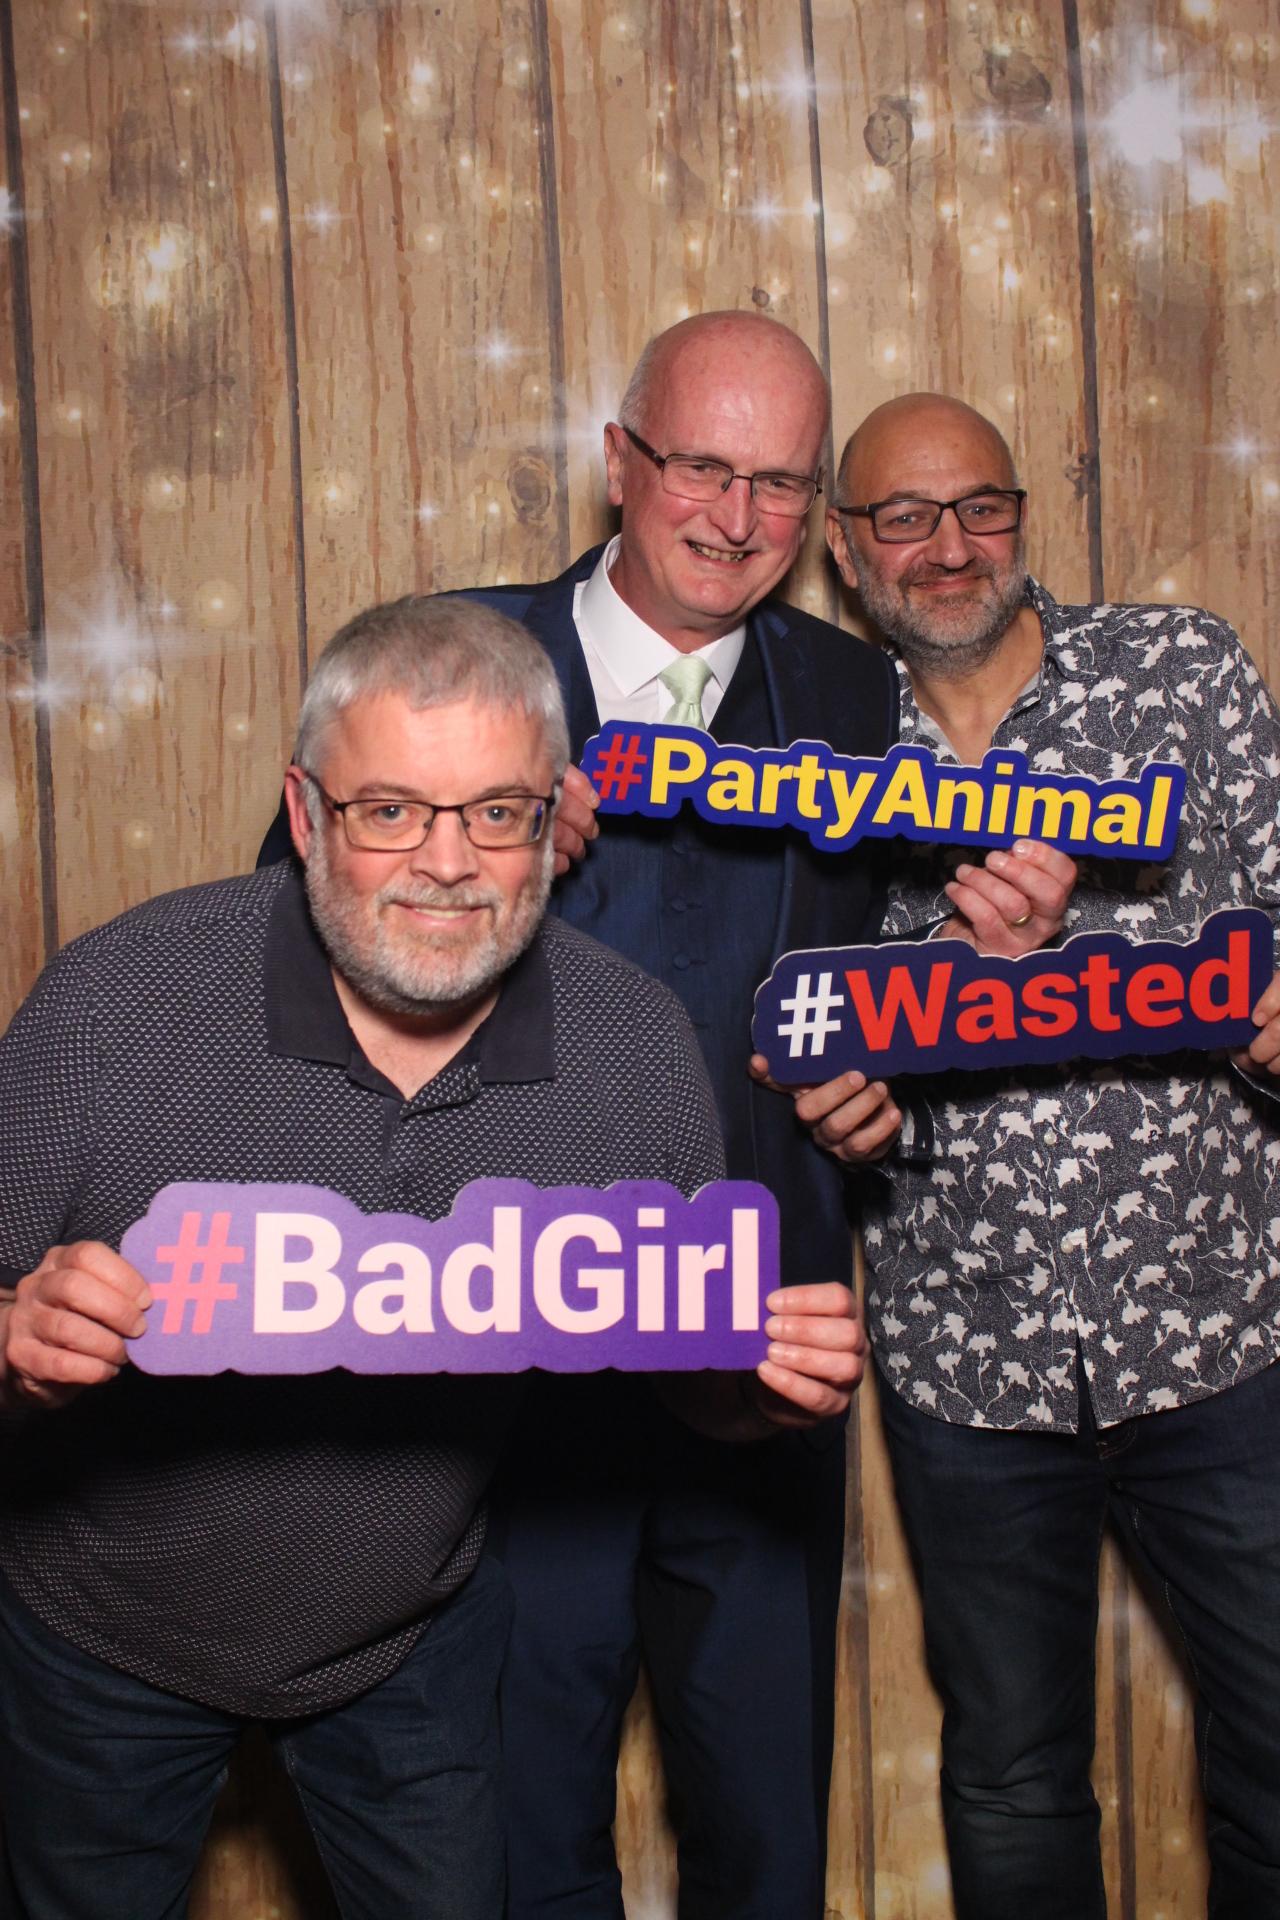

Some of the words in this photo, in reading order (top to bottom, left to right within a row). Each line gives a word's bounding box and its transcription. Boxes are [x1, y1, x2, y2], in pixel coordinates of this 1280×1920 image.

[593, 733, 1172, 848] #PartyAnimal
[777, 929, 1250, 1058] #Wasted
[150, 1206, 759, 1334] #BadGirl
